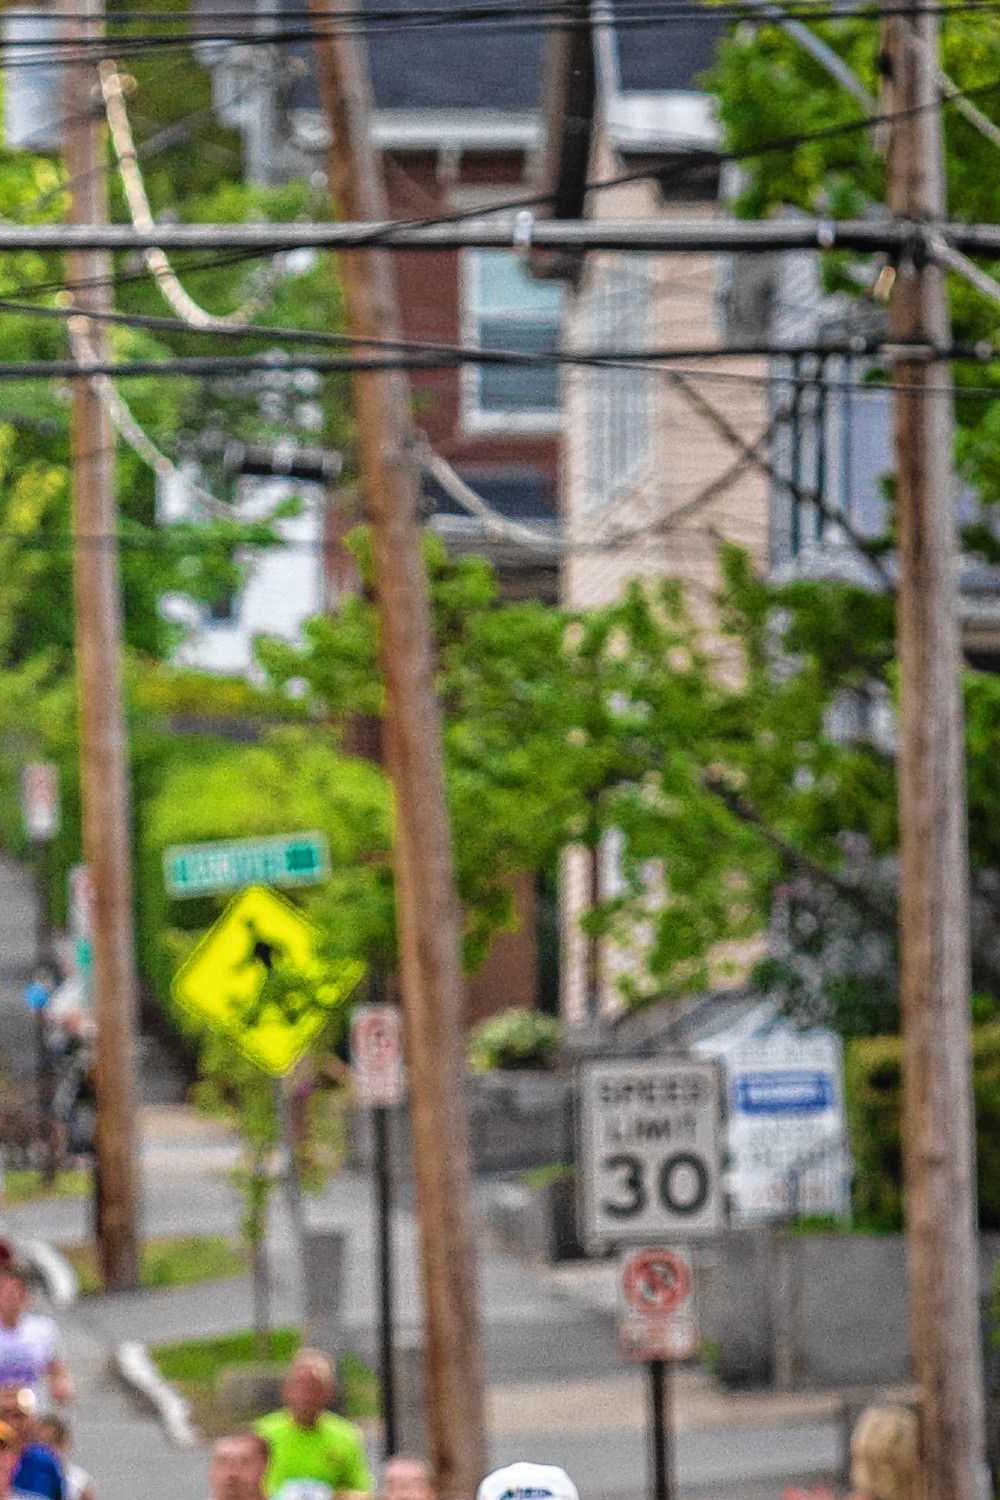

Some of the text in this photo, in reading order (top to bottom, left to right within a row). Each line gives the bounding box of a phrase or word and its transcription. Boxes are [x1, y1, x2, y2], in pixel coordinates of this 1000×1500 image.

[601, 1074, 706, 1103] SPEED
[606, 1115, 698, 1143] LIMIT
[602, 1151, 710, 1219] 30
